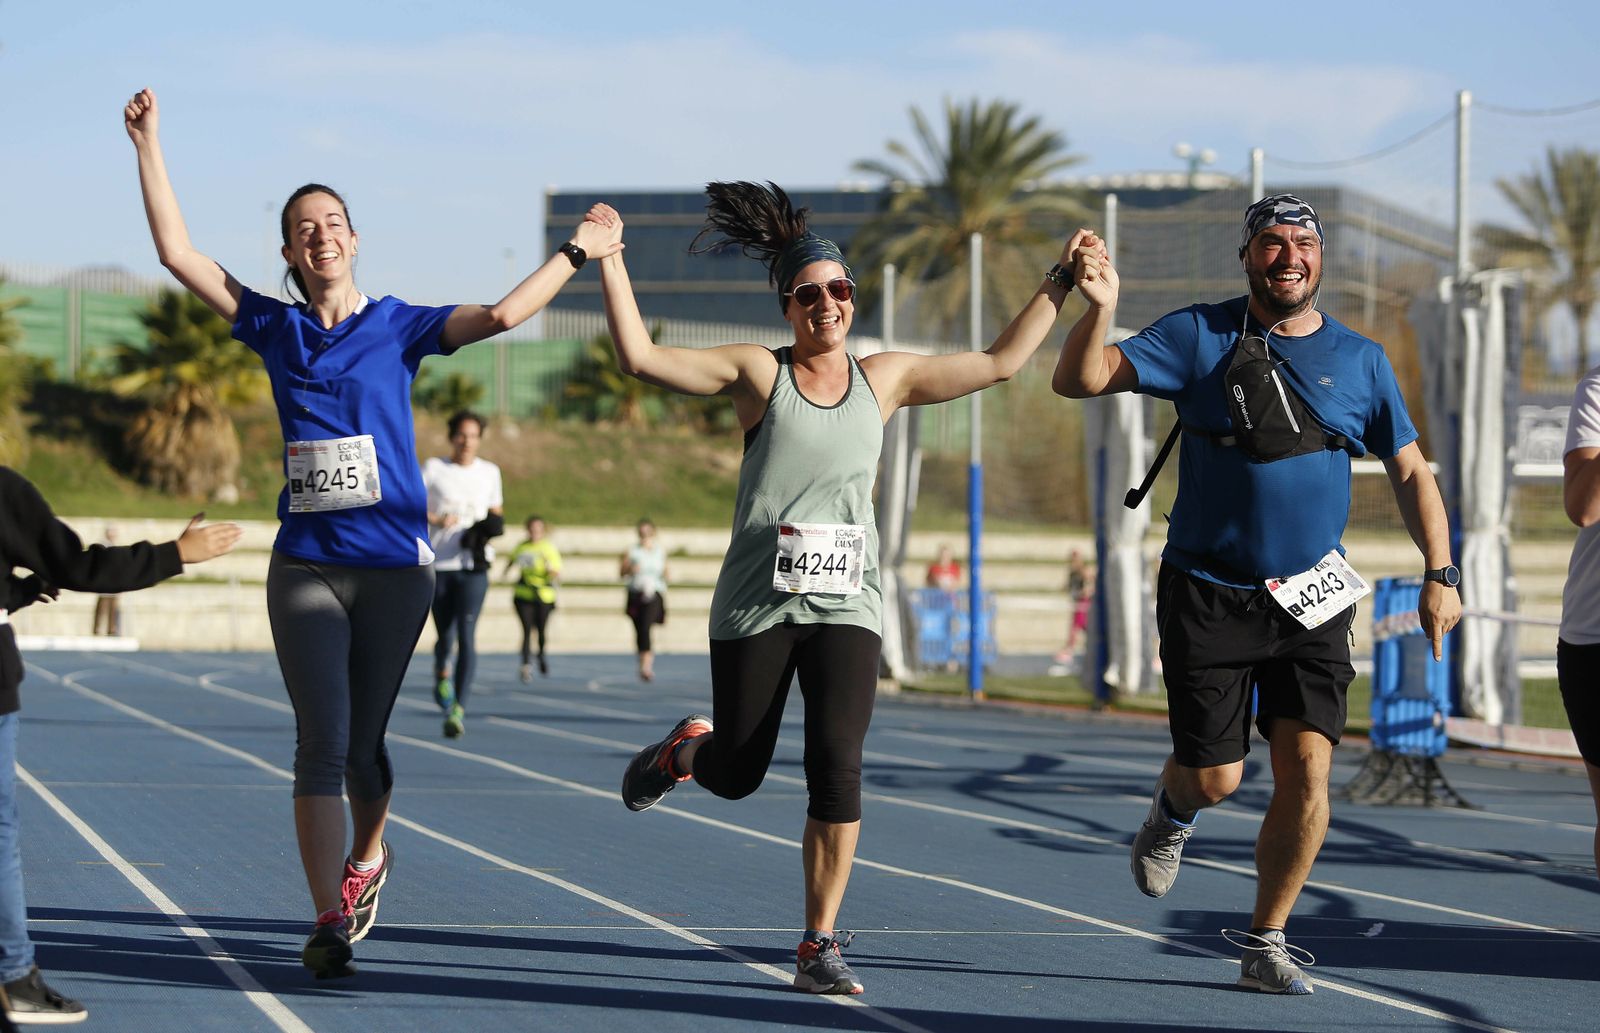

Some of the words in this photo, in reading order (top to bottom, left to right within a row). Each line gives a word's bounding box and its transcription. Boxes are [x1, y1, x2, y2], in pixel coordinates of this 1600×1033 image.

[1240, 402, 1253, 430] Kalenji
[305, 466, 359, 493] 4245
[794, 552, 847, 576] 4244
[1300, 572, 1345, 608] 4243
